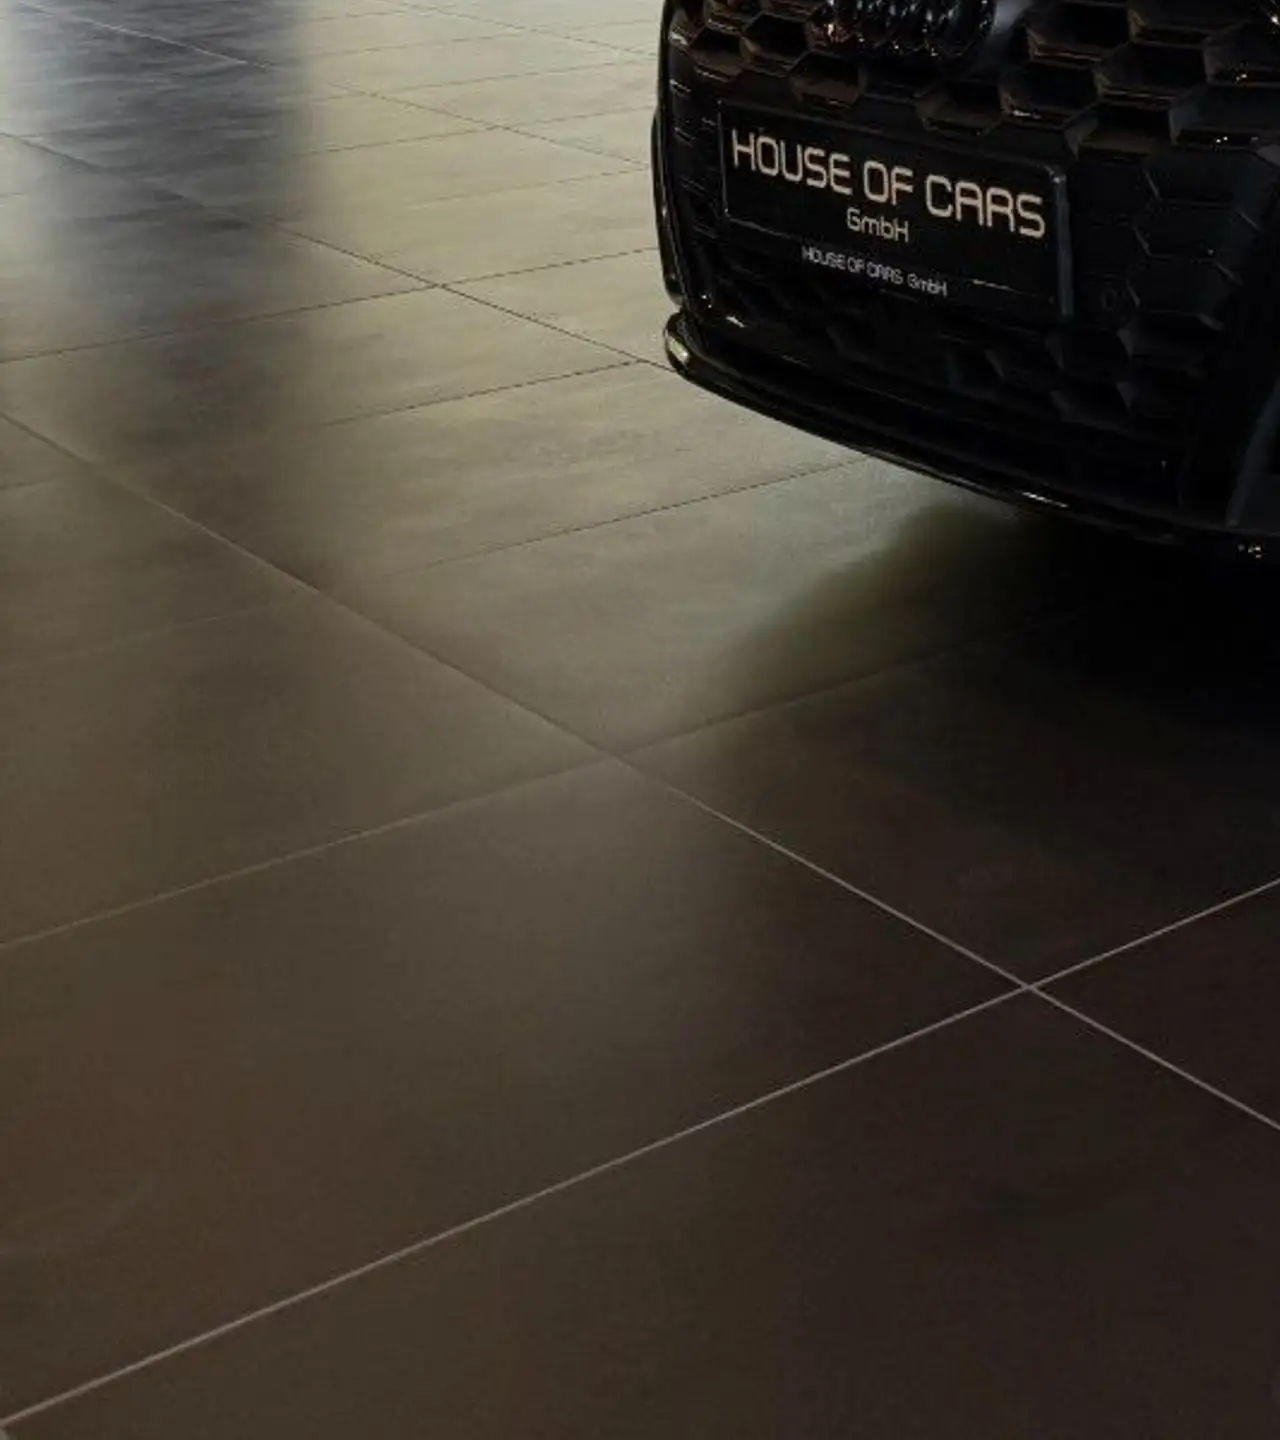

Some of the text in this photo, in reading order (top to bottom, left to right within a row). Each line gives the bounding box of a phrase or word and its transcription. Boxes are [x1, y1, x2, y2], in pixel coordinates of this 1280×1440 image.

[732, 129, 1046, 239] HOUSE OF CARS
[846, 207, 909, 243] GmbH
[801, 245, 948, 297] HOUSE OF CARS GmbH
